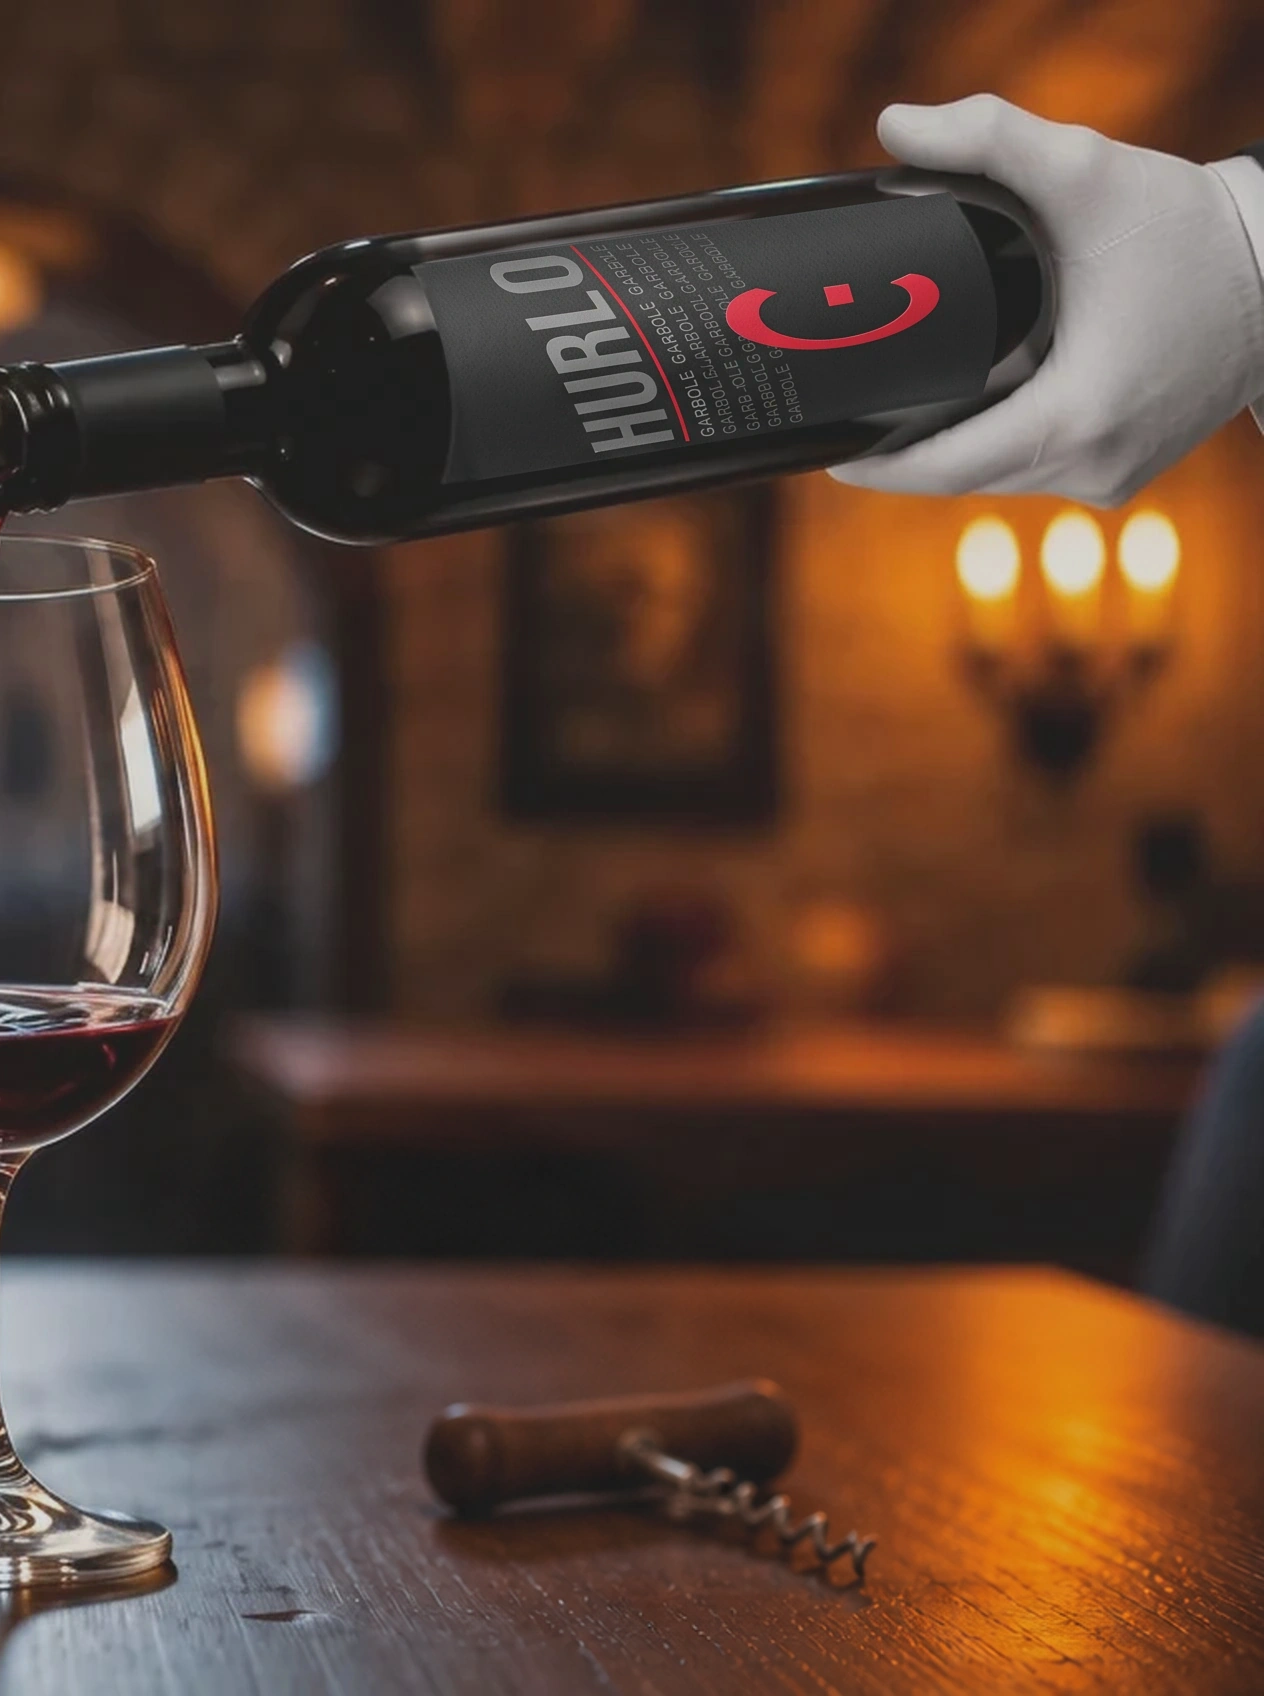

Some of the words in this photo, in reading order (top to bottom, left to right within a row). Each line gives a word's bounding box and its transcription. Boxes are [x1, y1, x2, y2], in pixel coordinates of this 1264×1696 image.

[615, 243, 674, 300] GARBOLE
[489, 254, 675, 454] HURLO
[639, 301, 686, 364] GARBOLE
[679, 369, 715, 437] GARBOLE
[775, 363, 803, 423] GARBOLE
